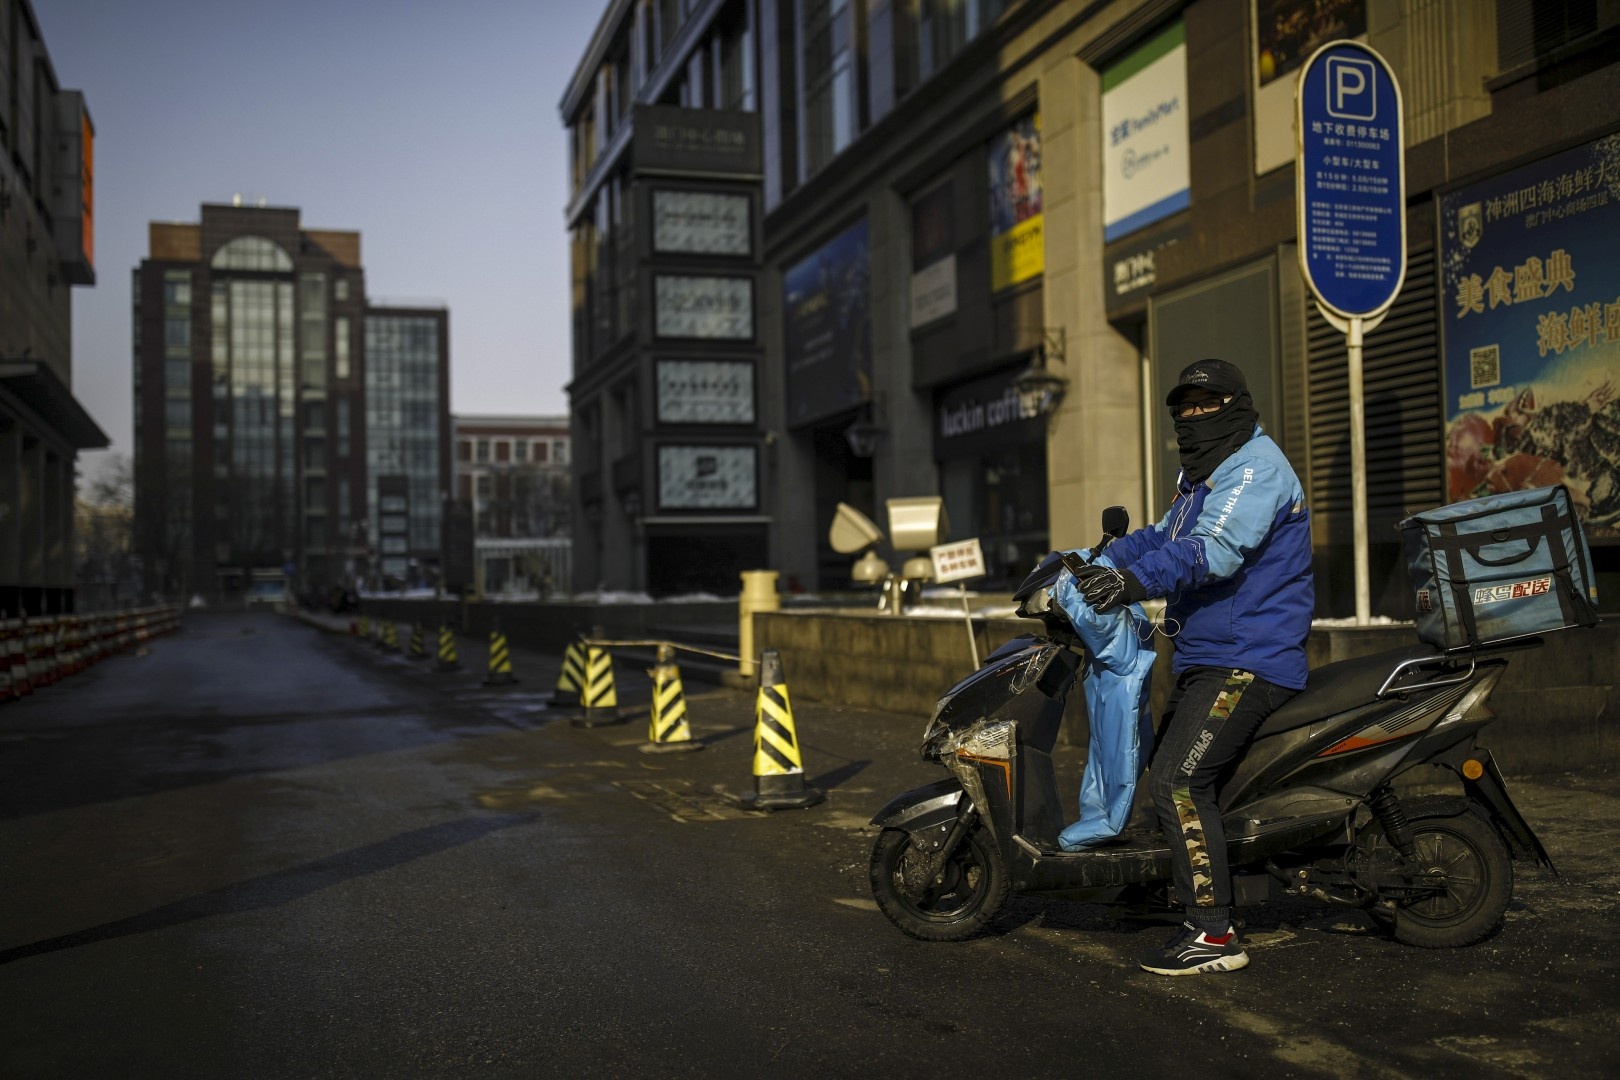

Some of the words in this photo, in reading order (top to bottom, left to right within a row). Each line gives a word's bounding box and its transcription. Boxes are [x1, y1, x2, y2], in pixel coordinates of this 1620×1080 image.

[1337, 65, 1366, 109] P
[1312, 120, 1390, 141] 地下收费停车场
[1456, 249, 1575, 319] 美食盛典
[942, 399, 985, 438] luckin
[1222, 497, 1238, 514] THE
[1475, 578, 1550, 604] 蜂鸟配送
